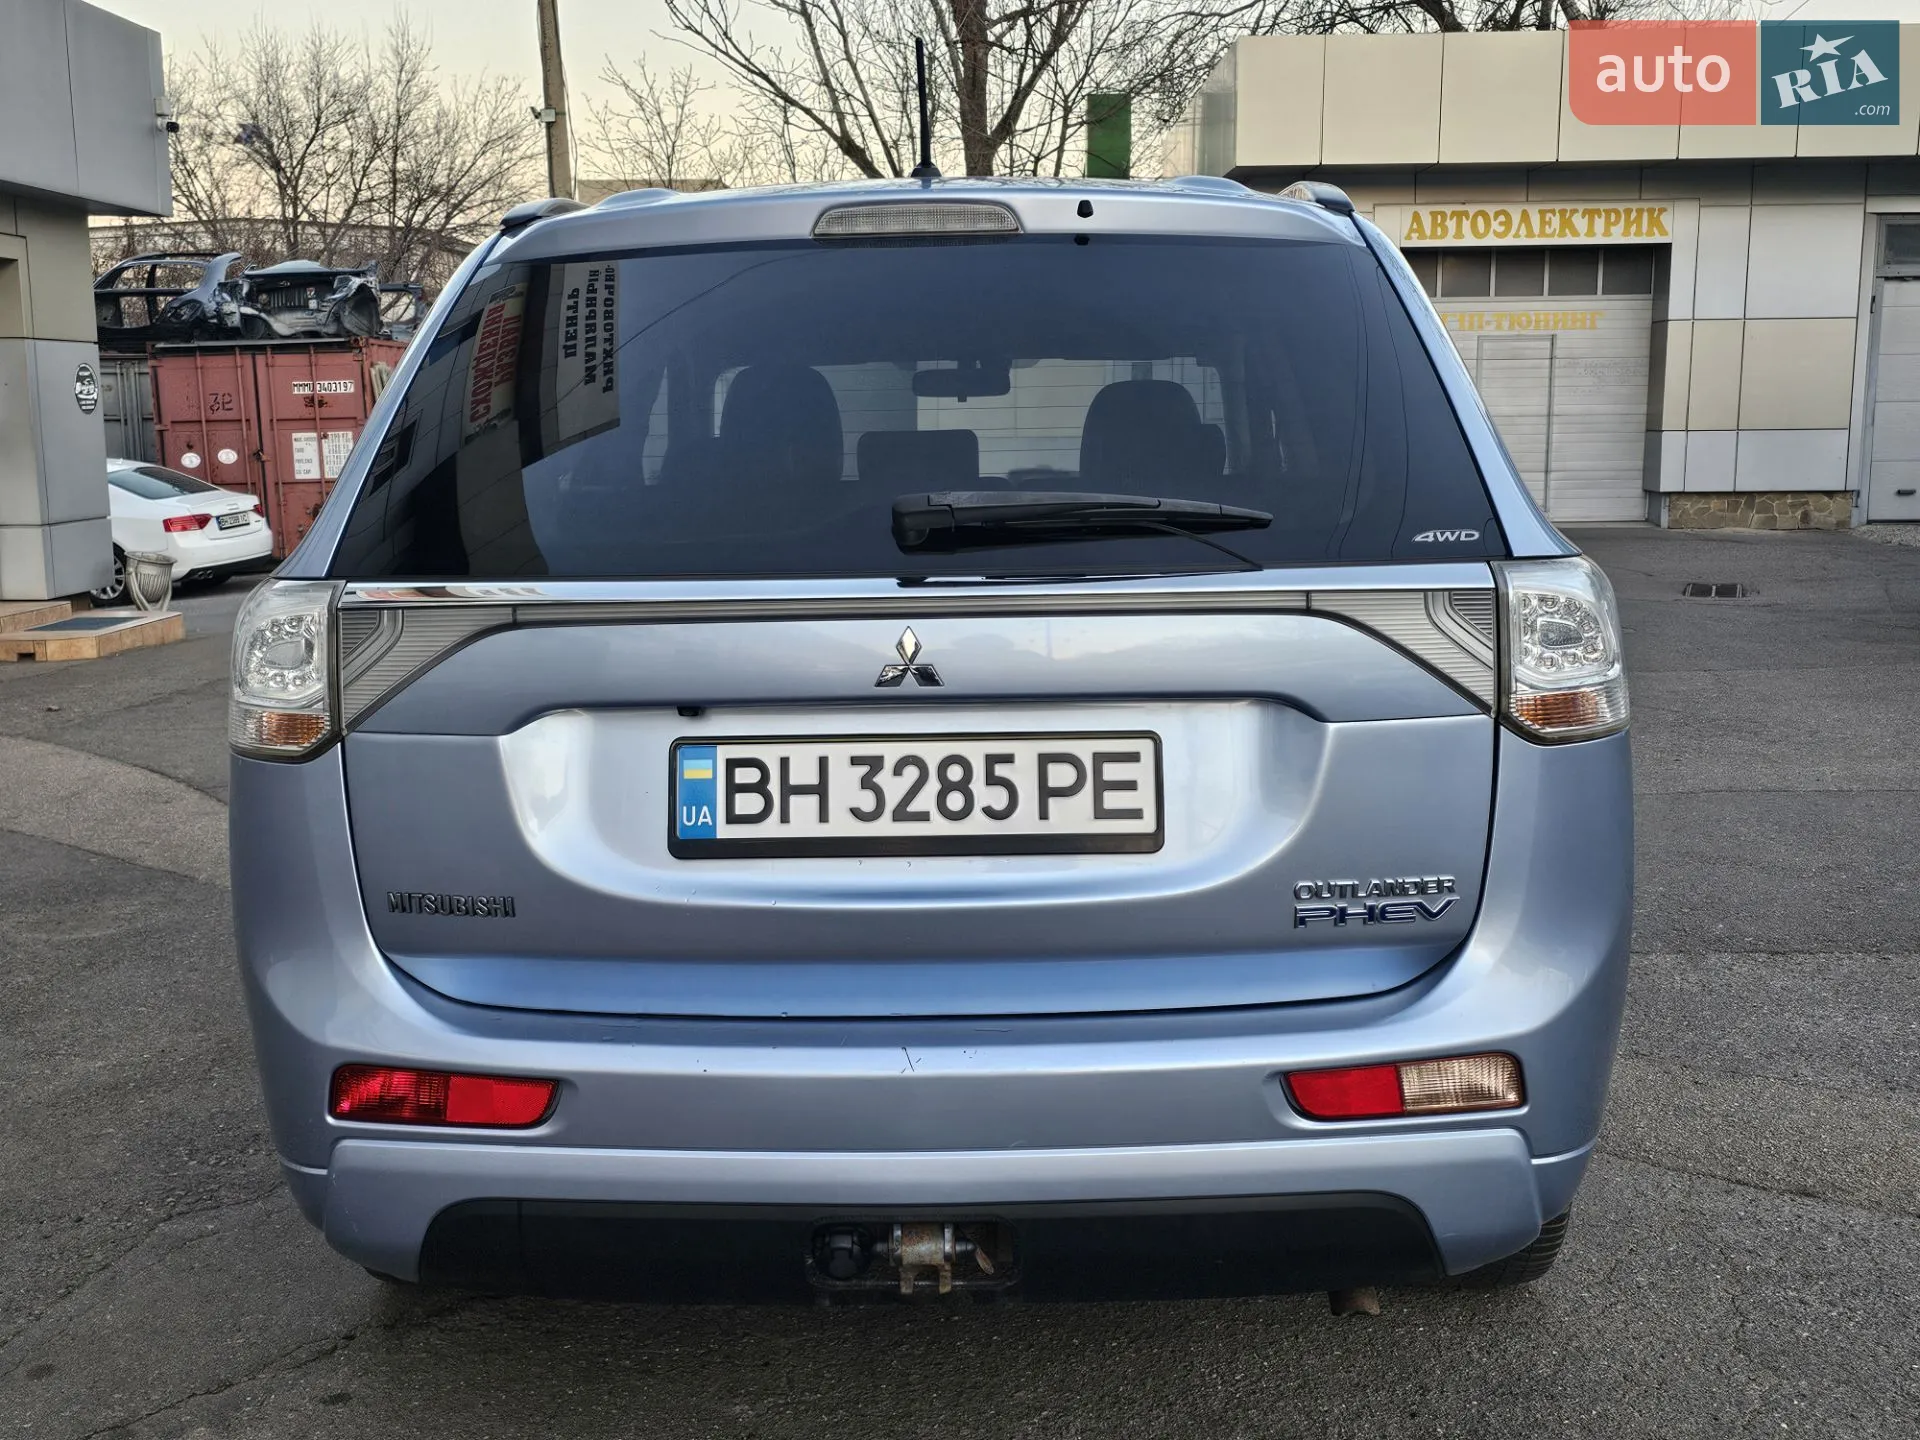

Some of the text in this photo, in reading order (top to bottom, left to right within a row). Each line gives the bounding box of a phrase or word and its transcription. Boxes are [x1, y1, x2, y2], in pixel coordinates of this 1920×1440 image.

[1404, 207, 1669, 241] АВТОЭЛЕКТРИК
[1412, 529, 1480, 543] 4WD
[725, 751, 1144, 825] BH 3285 PE
[682, 806, 713, 827] UA
[1294, 875, 1456, 900] OUTLANDER
[387, 892, 516, 918] MITSUBISHI
[1294, 896, 1461, 929] PHEV
